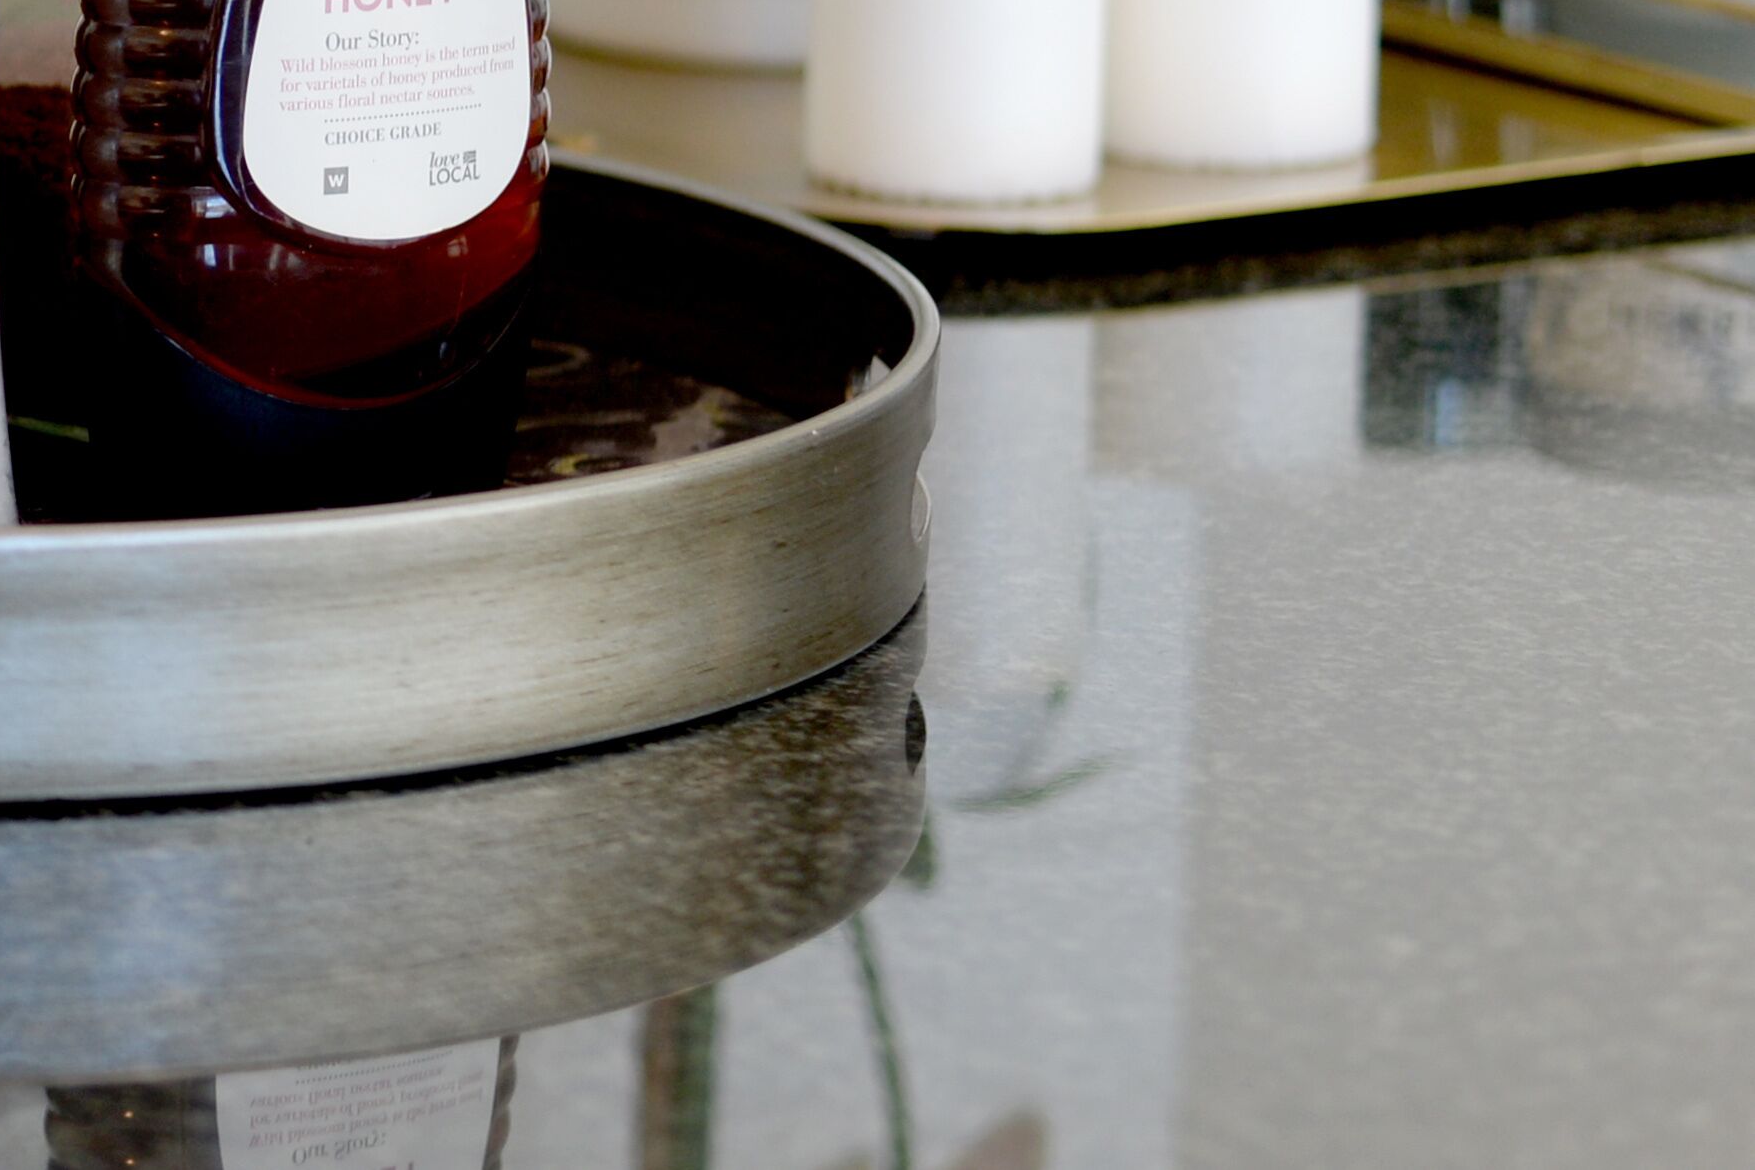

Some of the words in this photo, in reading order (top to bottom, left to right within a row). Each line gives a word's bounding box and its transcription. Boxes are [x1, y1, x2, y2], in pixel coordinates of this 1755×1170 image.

[325, 31, 362, 52] Our
[368, 29, 419, 51] Story:
[280, 57, 314, 74] Wild
[320, 55, 377, 72] blossom
[382, 52, 421, 69] honey
[426, 48, 436, 64] is
[439, 45, 459, 62] the
[462, 45, 489, 59] term
[492, 35, 515, 54] used
[280, 77, 301, 93] for
[306, 73, 367, 92] varietals
[370, 71, 385, 87] of
[389, 70, 427, 86] honey
[432, 60, 487, 85] produced
[489, 57, 514, 74] from
[279, 96, 333, 112] various
[338, 91, 375, 109] floral
[380, 89, 422, 106] nectar
[427, 84, 475, 101] sources.
[324, 128, 385, 147] CHOICE
[390, 121, 442, 141] GRADE
[429, 151, 460, 169] love
[429, 162, 480, 187] LOCAL
